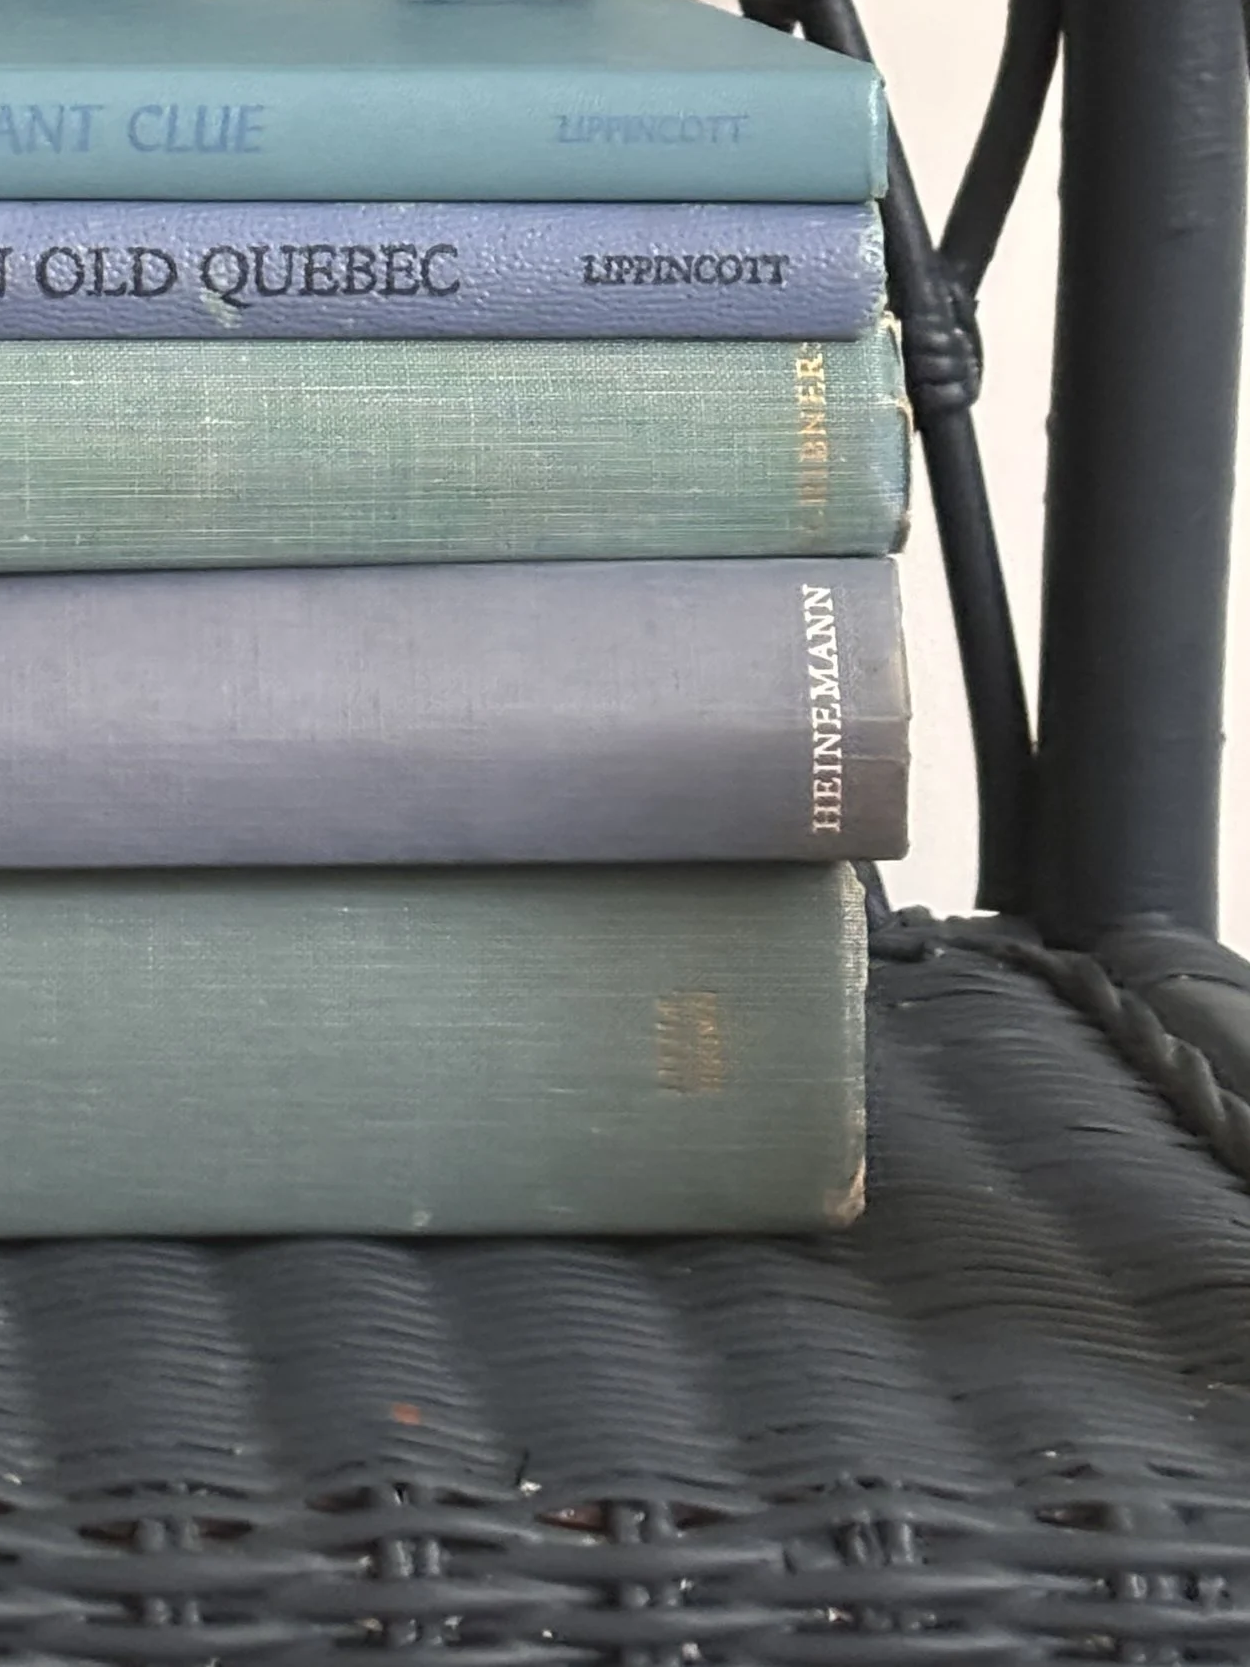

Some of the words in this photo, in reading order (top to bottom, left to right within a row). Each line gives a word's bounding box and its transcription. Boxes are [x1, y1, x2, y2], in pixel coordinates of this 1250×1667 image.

[126, 104, 265, 154] CLUE
[557, 112, 752, 144] LIPPINCOTT
[35, 245, 178, 298] OLD
[199, 242, 461, 309] QUEBEC
[582, 253, 789, 286] LIPPINCOTT
[801, 583, 844, 833] HEINEMANN
